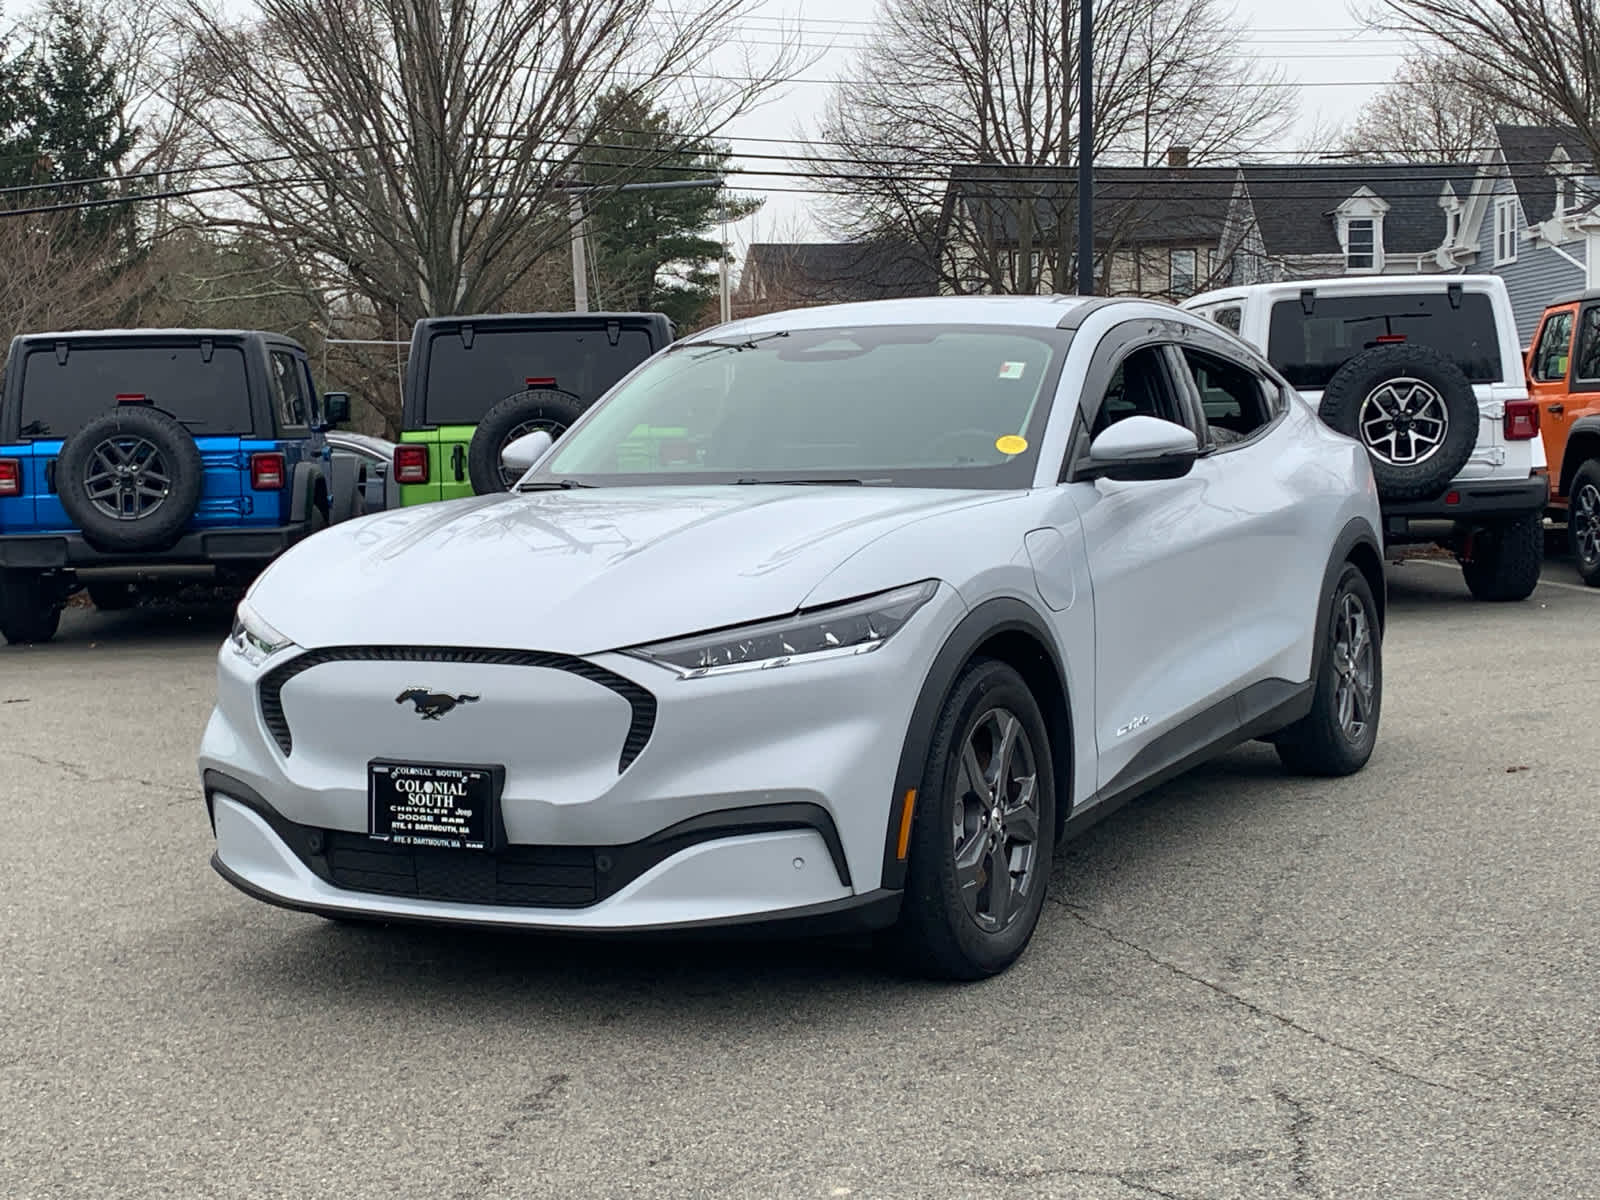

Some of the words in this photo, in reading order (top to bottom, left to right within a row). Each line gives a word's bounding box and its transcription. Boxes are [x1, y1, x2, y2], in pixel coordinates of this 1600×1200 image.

[396, 779, 467, 795] COLONIAL
[408, 793, 454, 808] SOUTH
[390, 805, 448, 815] CHRYSLER
[455, 808, 472, 818] Jeep
[397, 813, 434, 822] DODGE
[415, 823, 458, 834] DARTMOUTH,
